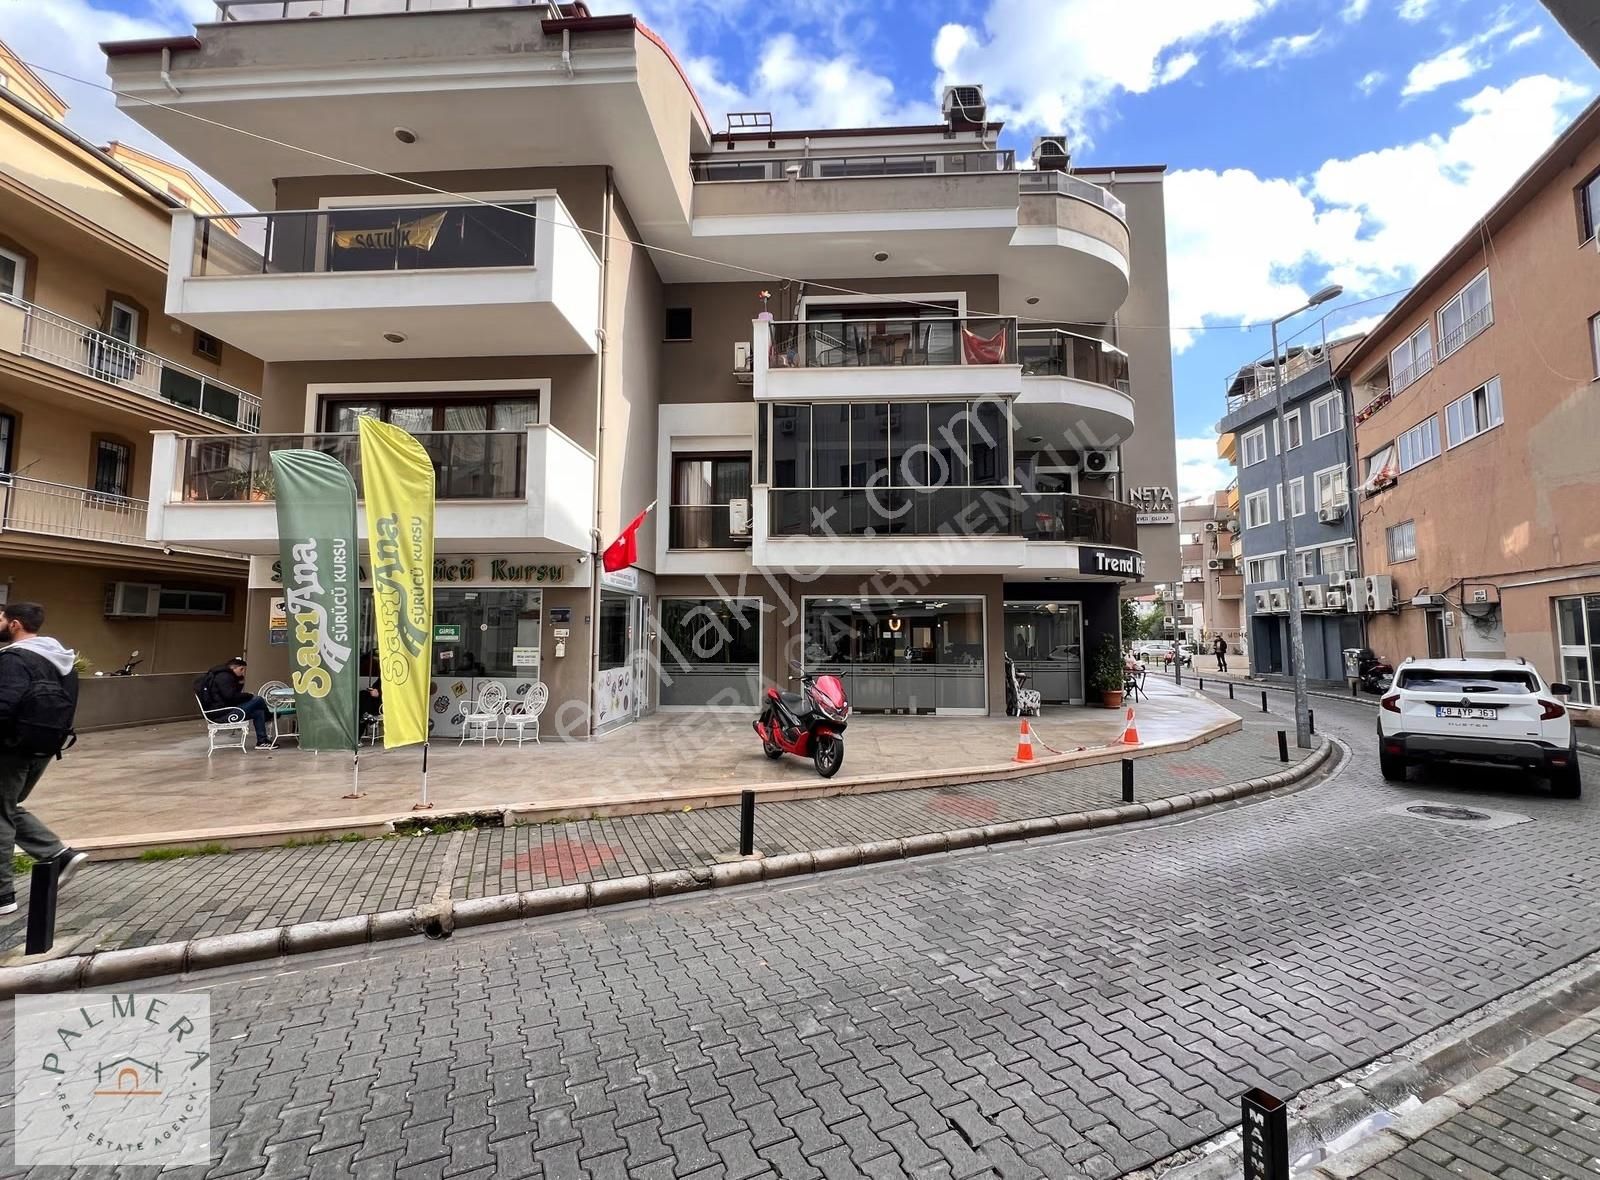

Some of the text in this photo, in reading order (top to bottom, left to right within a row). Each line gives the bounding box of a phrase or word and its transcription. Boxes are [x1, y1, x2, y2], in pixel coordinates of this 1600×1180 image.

[1129, 486, 1174, 501] NETA
[408, 515, 426, 625] SÜRÜCÜ KURSU
[491, 559, 565, 582] Kursu
[1096, 552, 1133, 573] Trend
[331, 538, 348, 642] SÜRÜCÜ KURSU
